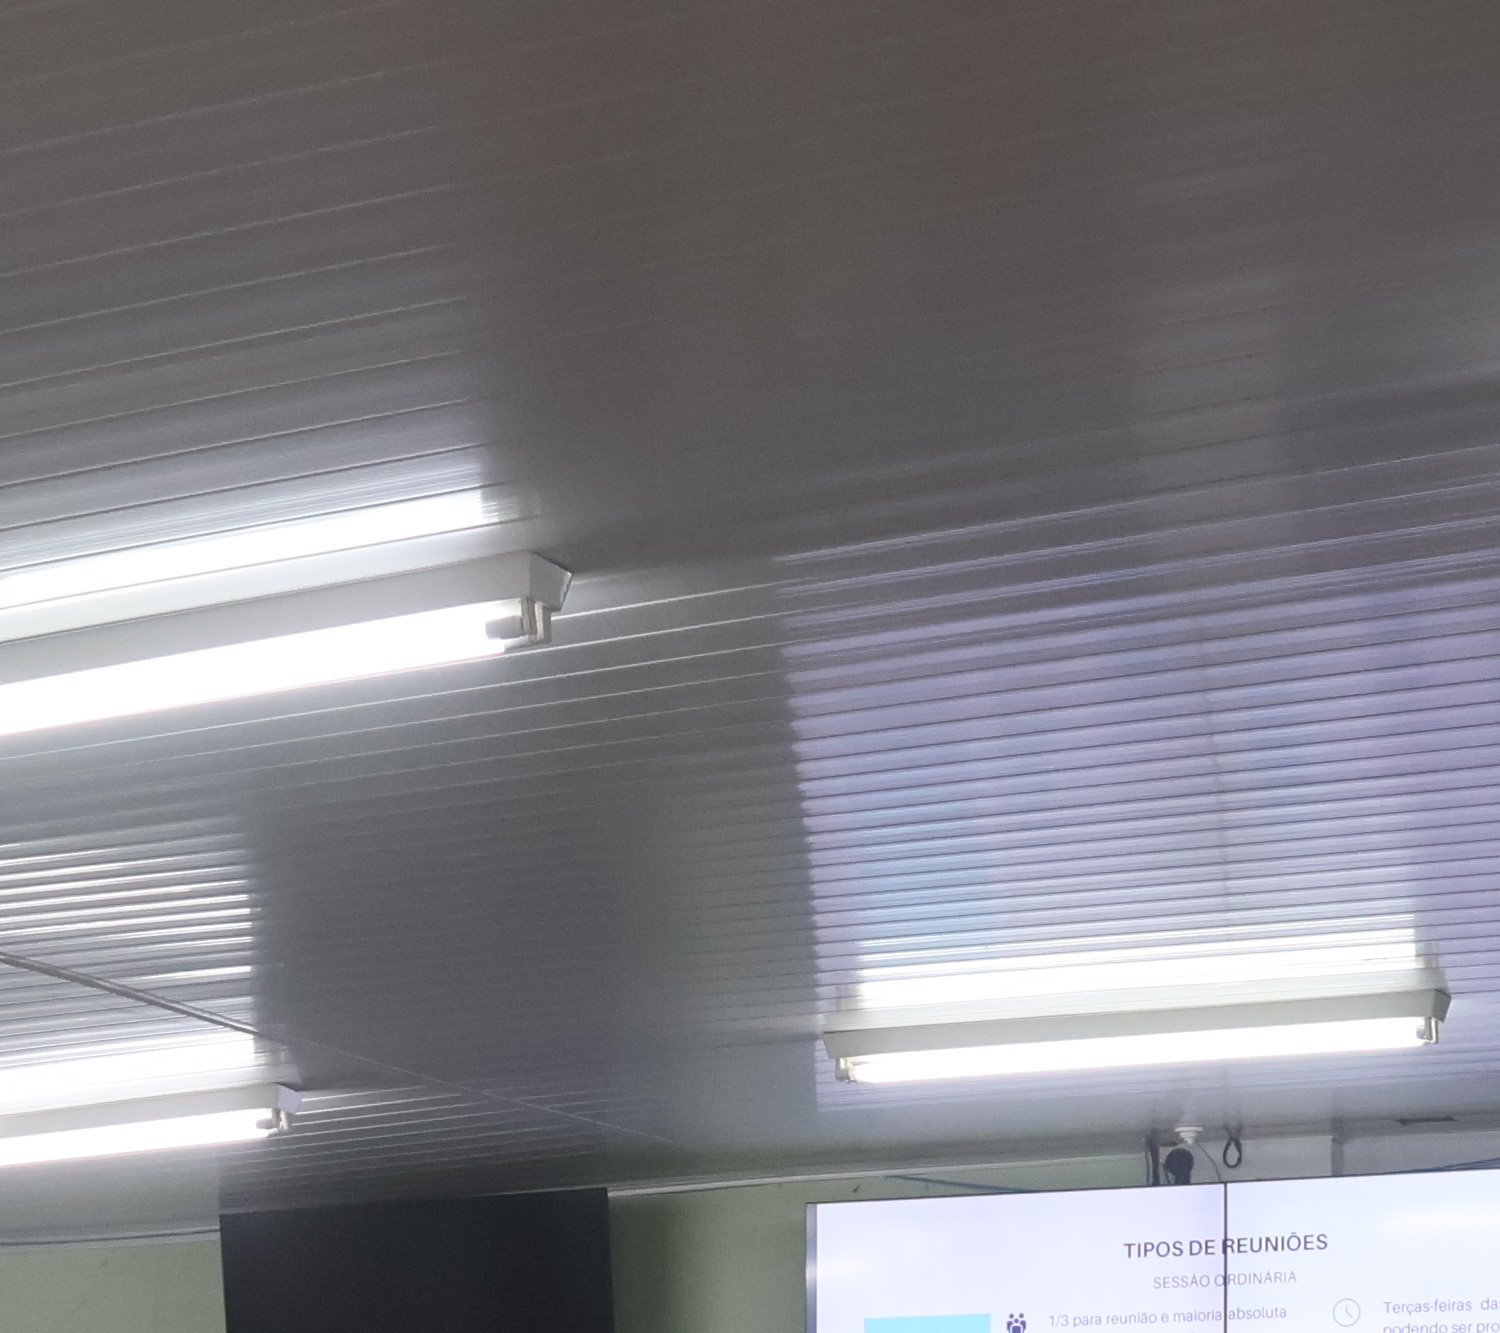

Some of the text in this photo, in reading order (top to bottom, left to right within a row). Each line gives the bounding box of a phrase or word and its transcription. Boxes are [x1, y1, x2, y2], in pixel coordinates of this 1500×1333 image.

[1124, 1233, 1328, 1258] TIPOS DE REUNIÕES
[1154, 1270, 1297, 1289] SESSÃO ORDINÁRIA
[1049, 1306, 1287, 1328] 1/3 para reunião maioria absoluta
[1384, 1299, 1472, 1316] Terças-feiras
[1452, 1324, 1472, 1333] ser
